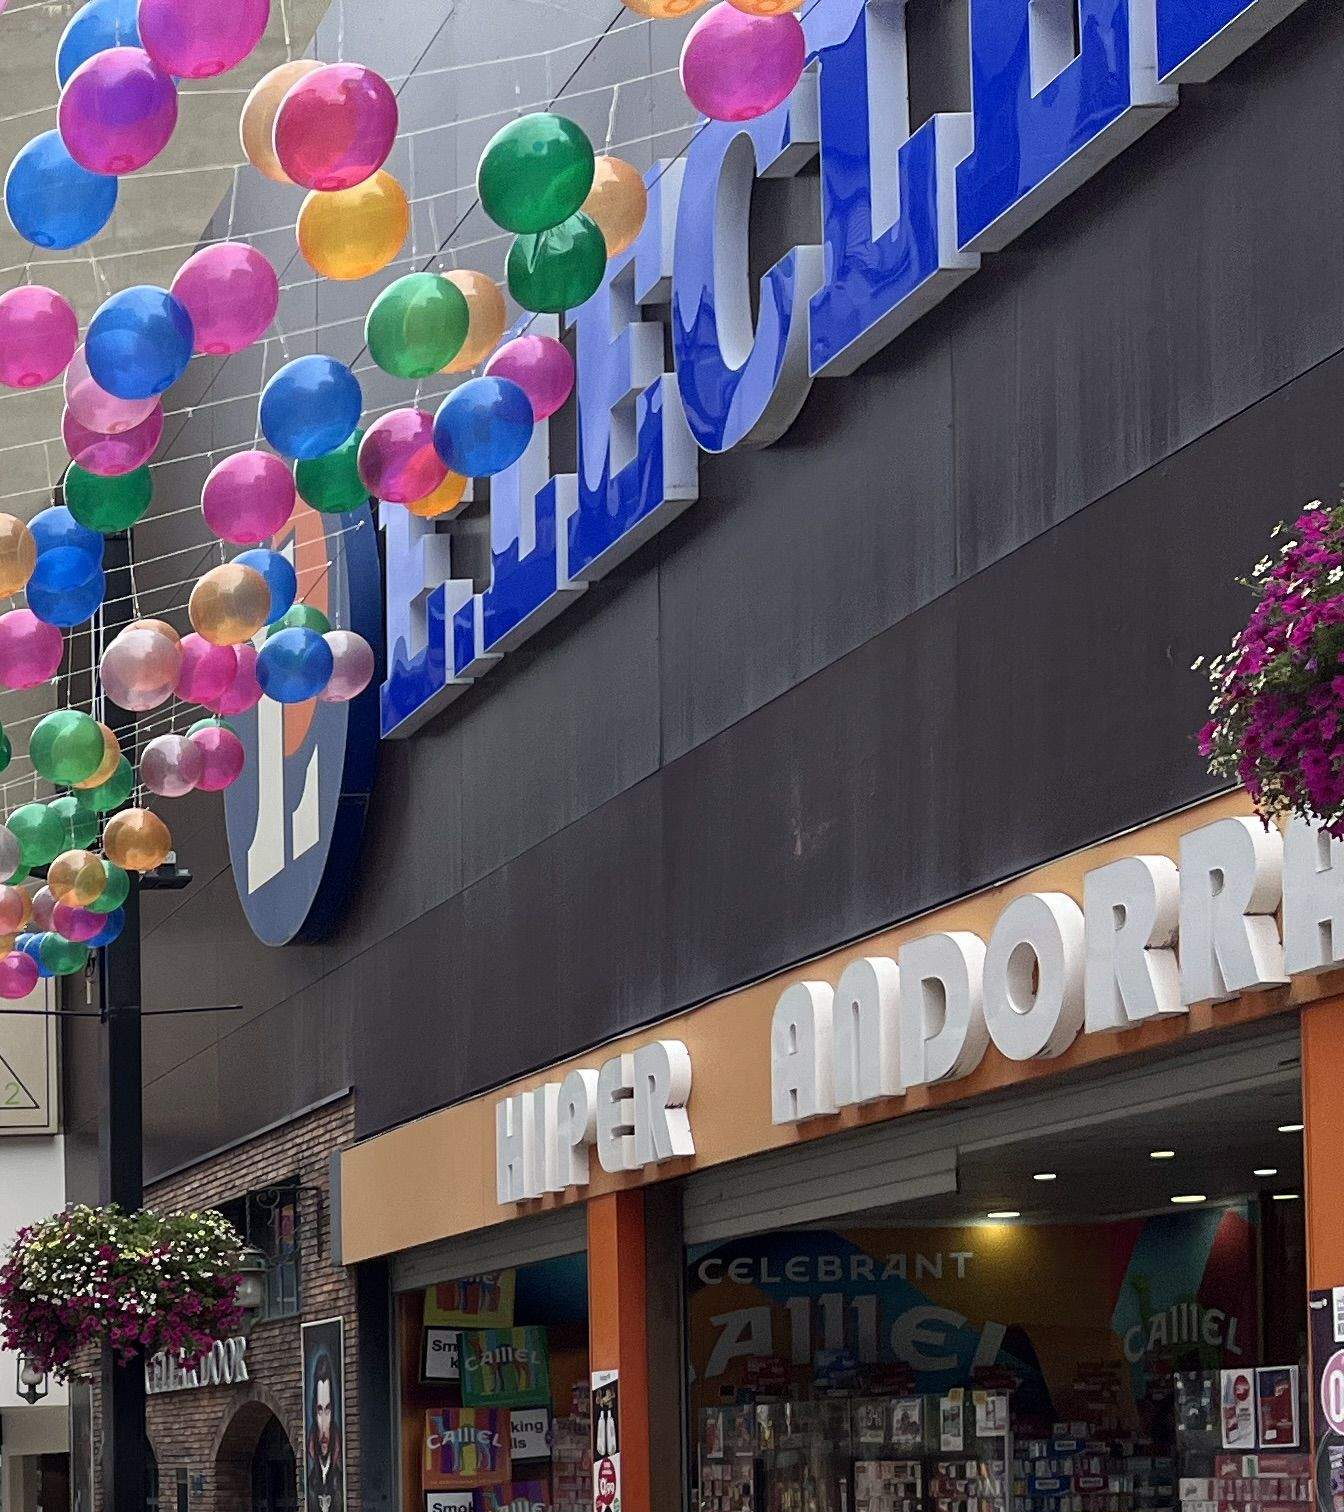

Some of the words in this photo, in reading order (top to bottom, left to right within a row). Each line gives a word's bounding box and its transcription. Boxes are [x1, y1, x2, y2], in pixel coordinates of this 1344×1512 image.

[381, 0, 1267, 740] E.LECL
[496, 1040, 695, 1205] HIPER
[772, 815, 1344, 1126] ANDORRA
[4, 1082, 20, 1105] 2
[698, 1252, 973, 1286] CELEBRANT
[1123, 1302, 1243, 1364] CAMEL
[464, 1345, 541, 1372] CAMEL
[426, 1425, 502, 1450] CAMEL
[512, 1420, 543, 1434] king
